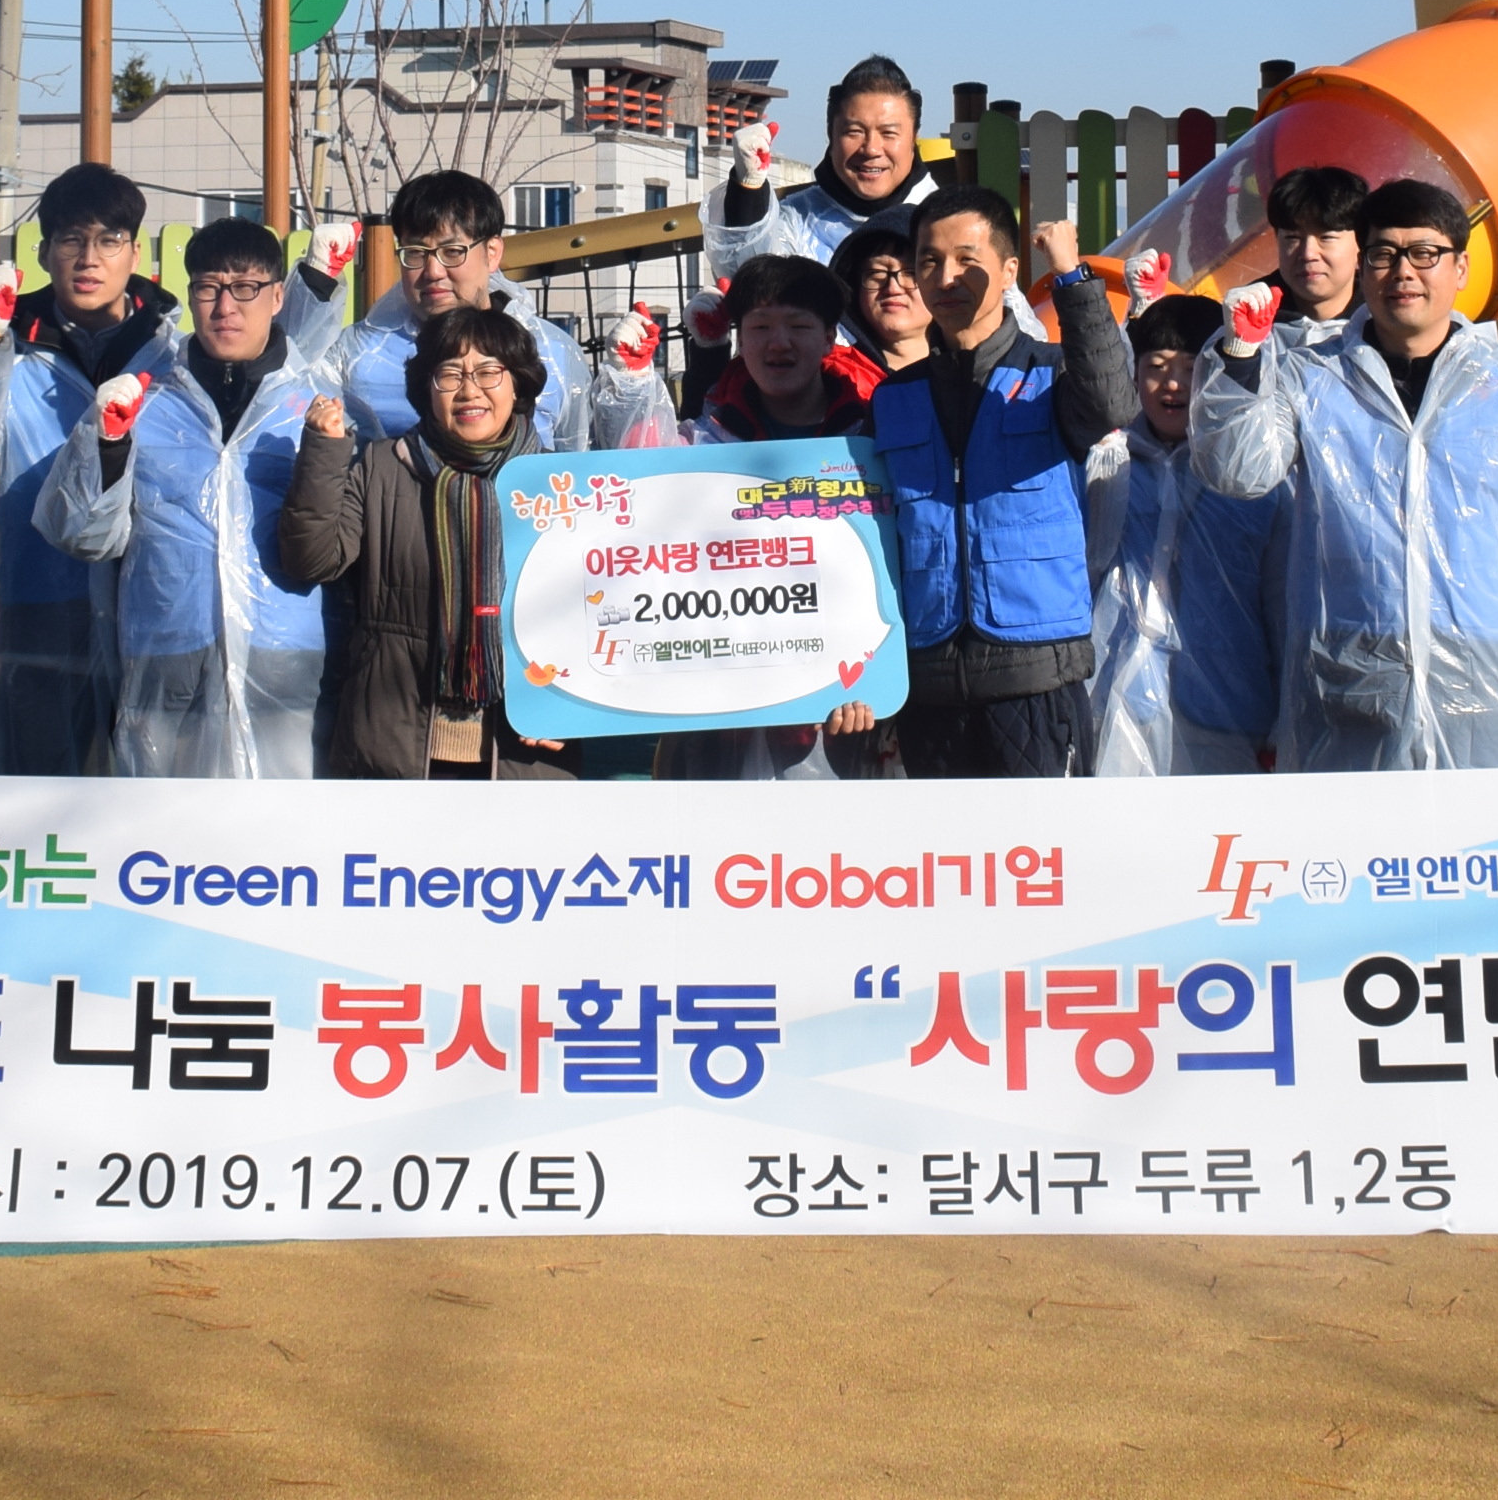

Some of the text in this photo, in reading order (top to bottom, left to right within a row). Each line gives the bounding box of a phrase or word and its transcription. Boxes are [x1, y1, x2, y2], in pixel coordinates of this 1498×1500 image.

[585, 535, 817, 577] 이웃사랑 연료뱅크
[634, 581, 819, 625] 2,000,000원
[117, 850, 319, 908] Green
[342, 853, 691, 925] Energy소재
[713, 844, 1066, 910] Global기업
[51, 978, 275, 1093] 나눔
[316, 978, 782, 1100] 봉사활동
[95, 1150, 606, 1219] 2019.12.07.(토)
[745, 1151, 889, 1218] 장소:
[919, 1149, 1109, 1216] 달서구
[1134, 1147, 1262, 1216] 두류
[1291, 1143, 1457, 1213] 1,2동
